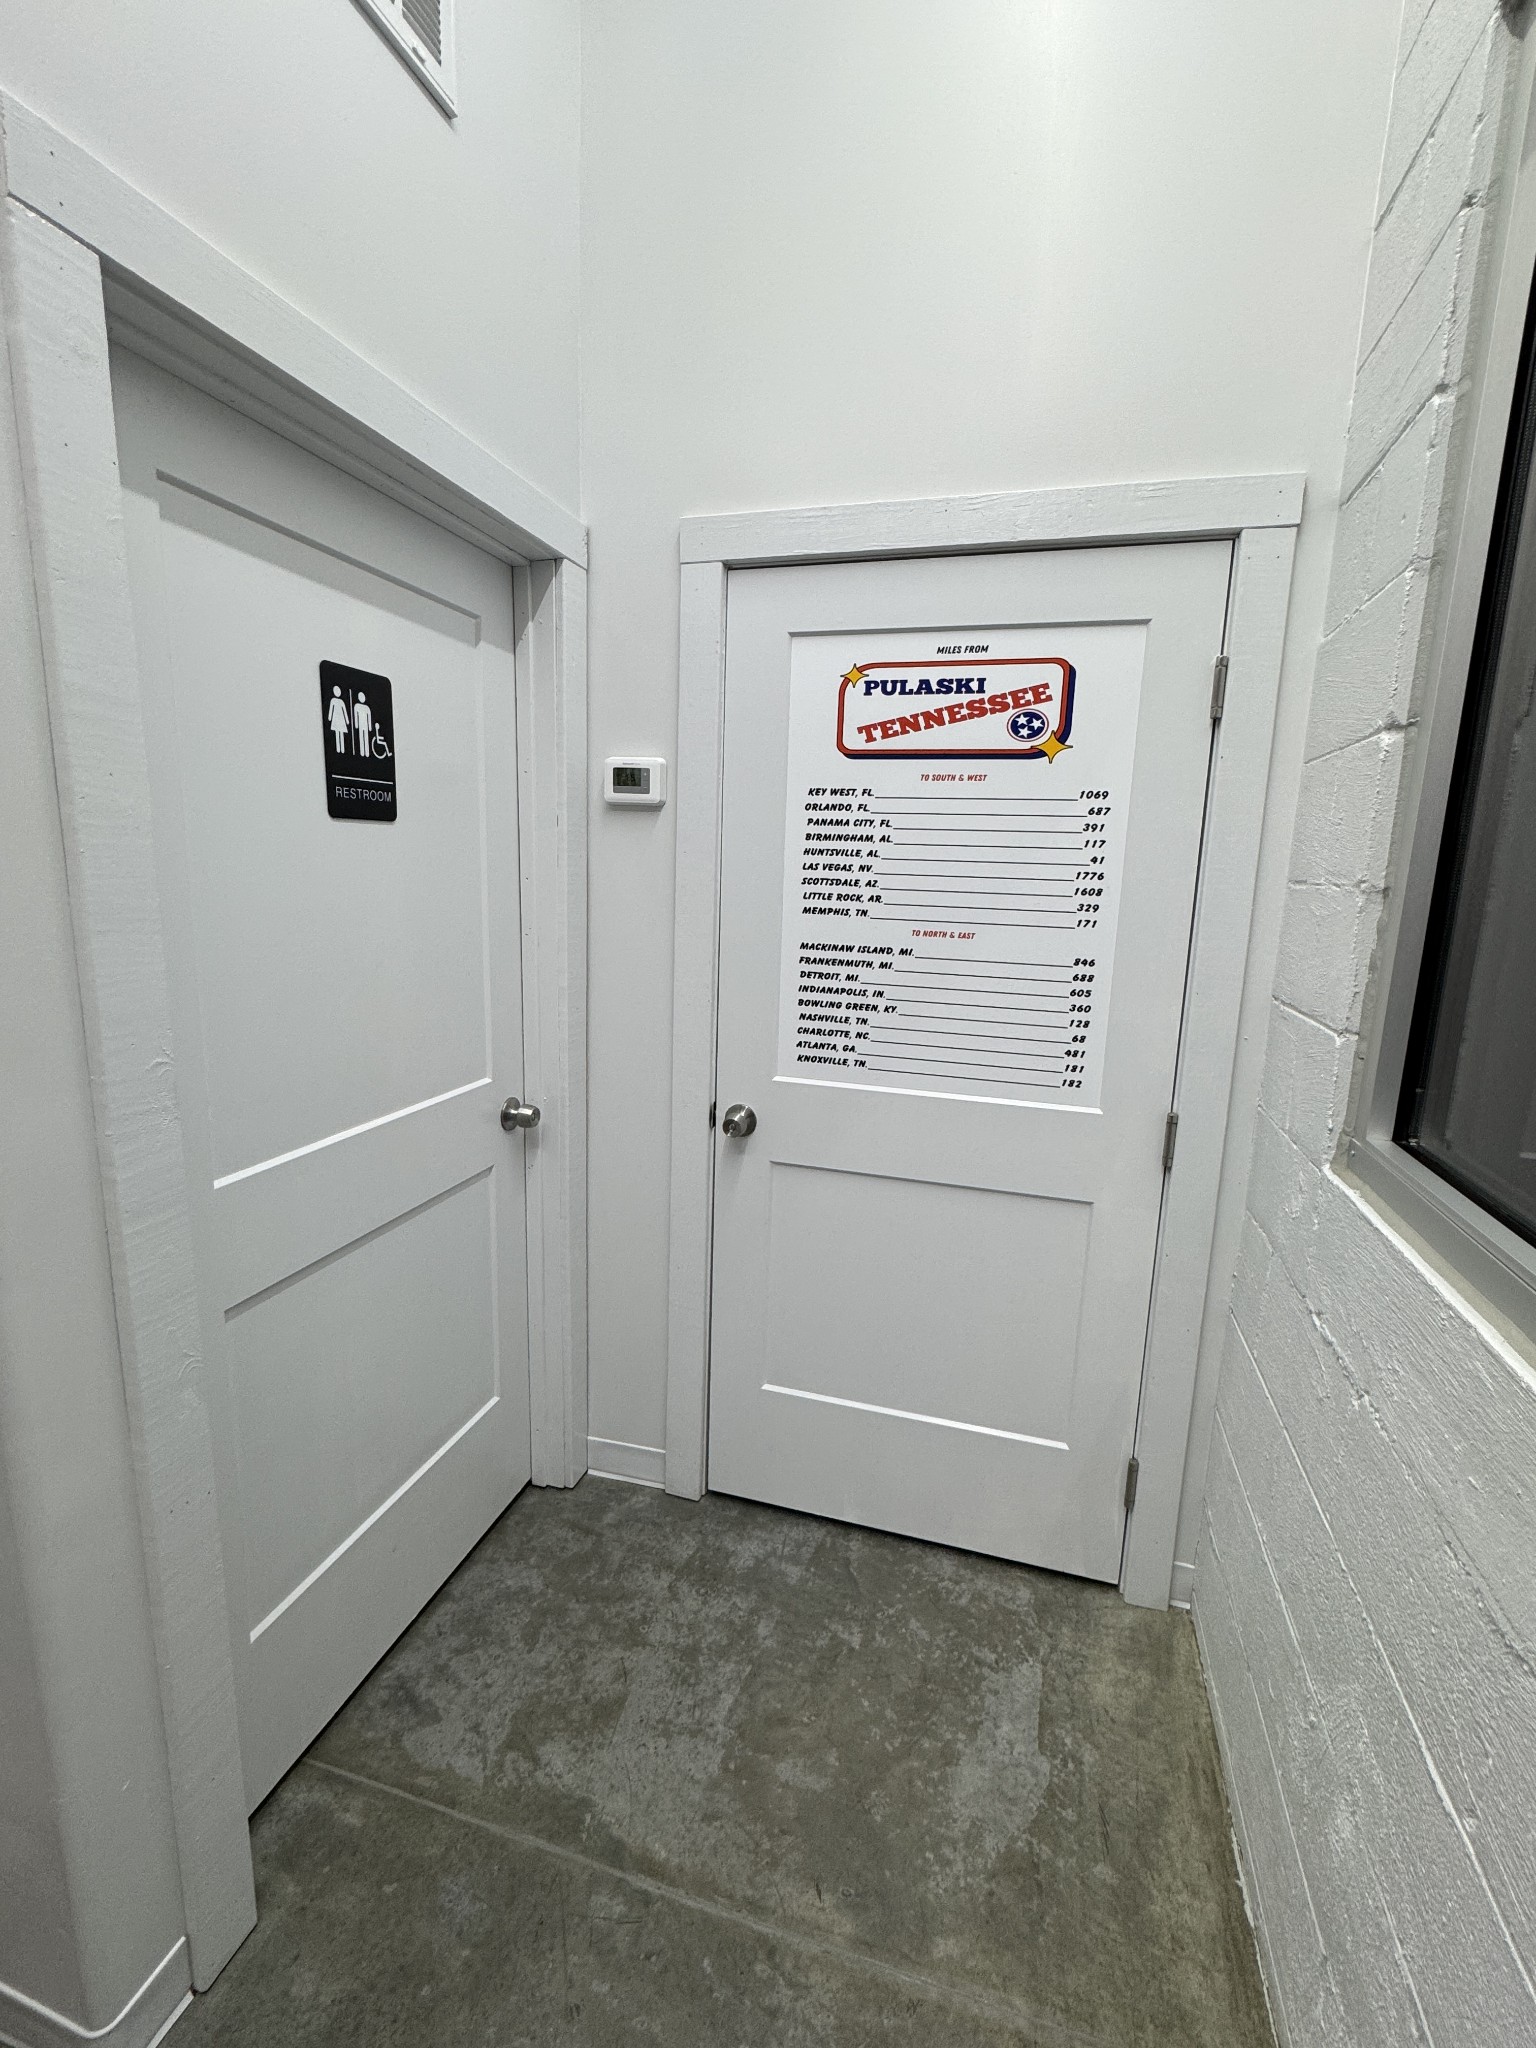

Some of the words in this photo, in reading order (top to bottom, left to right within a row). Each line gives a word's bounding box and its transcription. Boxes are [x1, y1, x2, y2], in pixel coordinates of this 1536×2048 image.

[936, 645, 962, 655] MILES
[963, 645, 990, 654] FROM
[863, 677, 987, 697] PULASKI
[856, 683, 1054, 744] TENNESSEE
[920, 774, 930, 782] TO
[931, 774, 957, 782] SOUTH
[958, 774, 965, 782] &
[967, 774, 988, 782] WEST
[335, 786, 392, 802] RESTROOM
[807, 787, 828, 797] KEY
[830, 788, 858, 798] WEST,
[1079, 790, 1109, 800] 1069
[804, 803, 854, 813] ORLANDO,
[1087, 807, 1111, 816] 687
[806, 818, 850, 827] PANAMA
[853, 819, 877, 829] CITY,
[1082, 823, 1105, 833] 391
[805, 833, 876, 844] BIRMINGHAM,
[1084, 840, 1107, 849] 117
[803, 848, 863, 859] HUNTSVILLE,
[1089, 856, 1106, 865] 41
[802, 862, 820, 871] LAS
[822, 863, 855, 873] VEGAS,
[1075, 871, 1105, 881] 1776
[801, 877, 862, 888] SCOTTSDALE,
[1074, 887, 1104, 897] 1608
[802, 892, 834, 901] LITTLE
[835, 893, 864, 903] ROCK,
[1076, 904, 1100, 913] 329
[802, 906, 852, 918] MEMPHIS,
[1076, 919, 1098, 929] 171
[911, 929, 921, 937] TO
[922, 930, 948, 938] NORTH
[957, 932, 976, 940] EAST
[799, 942, 855, 953] MACKINAW
[857, 945, 895, 957] ISLAND,
[1072, 958, 1096, 968] 846
[799, 956, 875, 970] FRANKENMUTH,
[1072, 974, 1095, 983] 688
[800, 970, 842, 982] DETROIT,
[1069, 989, 1092, 998] 605
[798, 985, 869, 998] INDIANAPOLIS,
[1069, 1004, 1092, 1013] 360
[798, 999, 843, 1009] BOWLING
[845, 1002, 880, 1013] GREEN,
[1069, 1019, 1091, 1029] 128
[799, 1013, 852, 1025] NASHVILLE,
[1071, 1035, 1087, 1044] 68
[797, 1027, 852, 1040] CHARLOTTE,
[1063, 1049, 1086, 1059] 481
[796, 1040, 839, 1053] ATLANTA,
[1064, 1064, 1085, 1074] 181
[797, 1054, 850, 1068] KNOXVILLE,
[1061, 1079, 1083, 1089] 182
